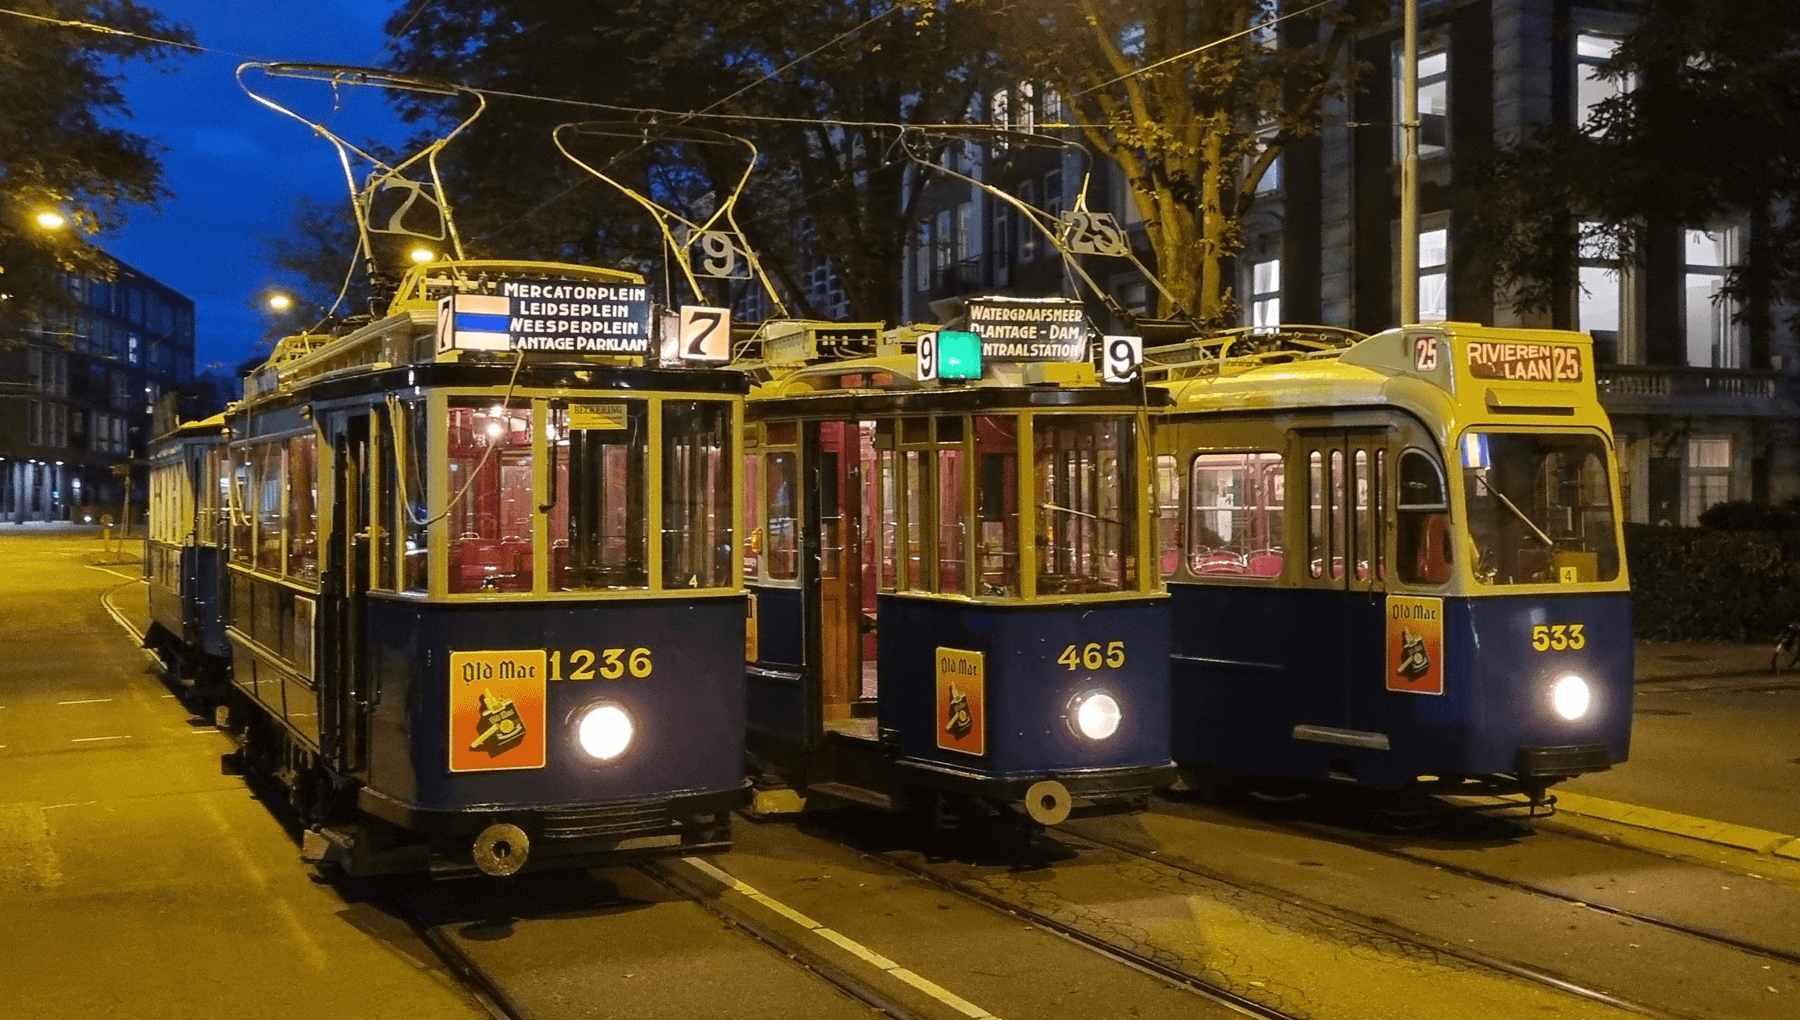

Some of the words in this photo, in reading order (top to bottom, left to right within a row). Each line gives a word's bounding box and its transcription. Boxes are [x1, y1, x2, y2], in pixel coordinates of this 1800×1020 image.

[1065, 212, 1121, 254] 25
[702, 231, 734, 277] 9
[504, 282, 646, 301] MERCATORPLEIN
[520, 300, 629, 318] LEIDSEPLEIN
[970, 305, 1083, 322] WATERGRAAFSMEER
[440, 300, 450, 349] 7
[687, 311, 722, 356] 7
[1049, 324, 1080, 340] DAM
[576, 336, 648, 352] PARKLAAN
[921, 336, 932, 378] 9
[1416, 337, 1438, 370] 25
[1466, 343, 1550, 365] RIVIEREN
[1109, 339, 1135, 379] 9
[1504, 359, 1552, 380] LAAN
[1554, 348, 1580, 380] 25
[688, 574, 698, 588] 4
[1564, 569, 1572, 582] 4
[1392, 604, 1410, 620] Old
[1532, 624, 1586, 652] 533
[549, 647, 654, 681] 1236
[941, 656, 956, 675] Old
[1057, 641, 1126, 671] 465
[461, 661, 494, 687] Old
[499, 659, 537, 680] Mac
